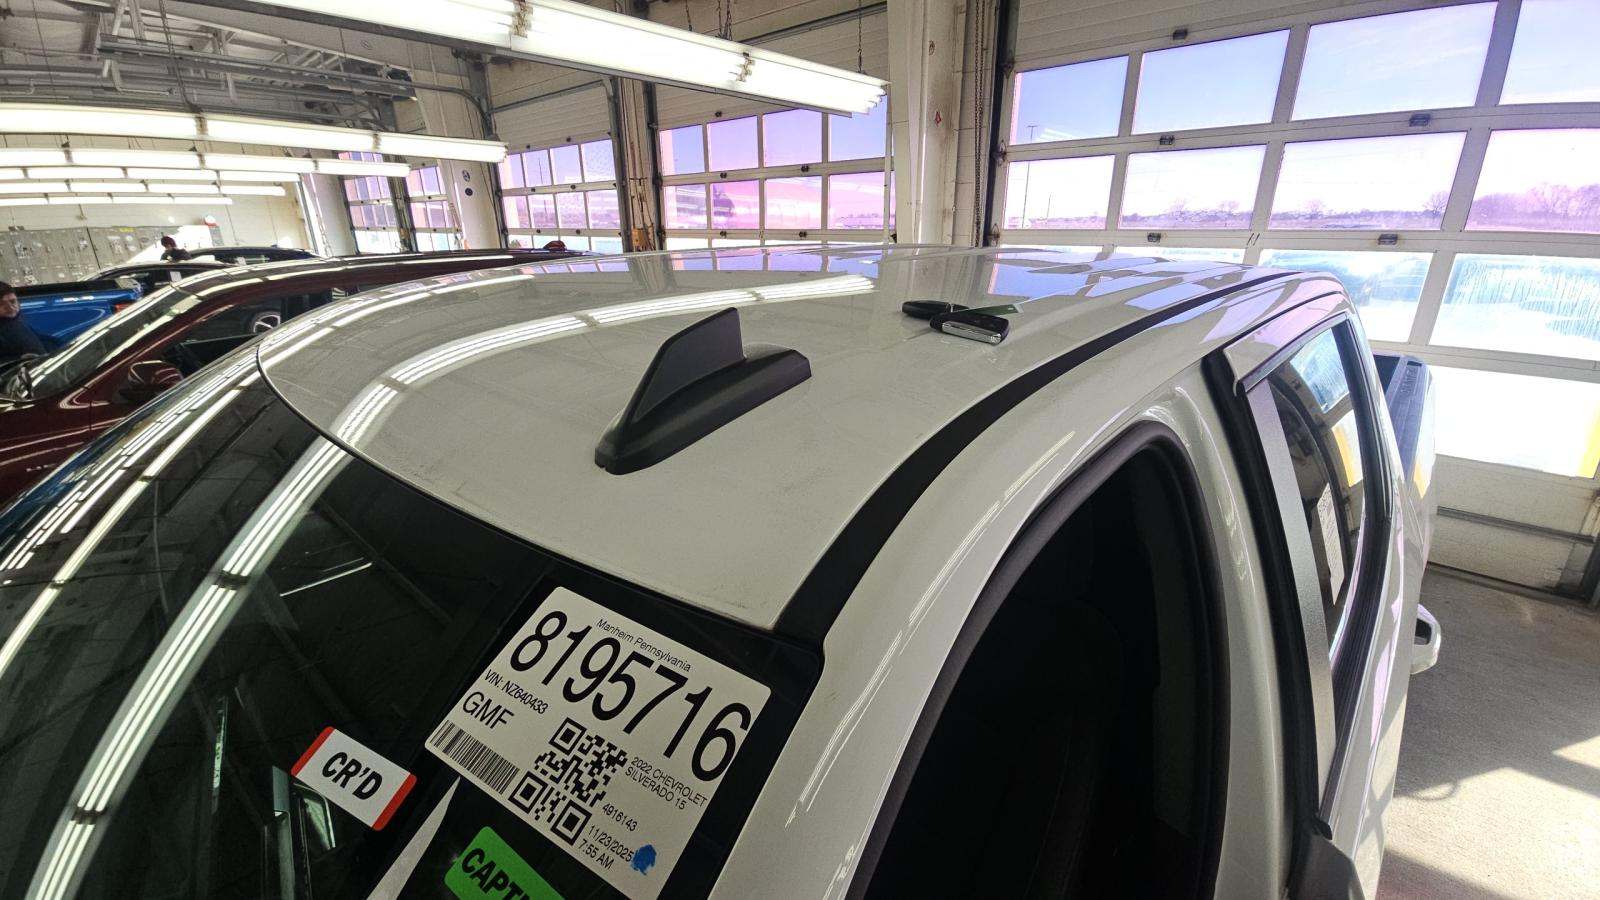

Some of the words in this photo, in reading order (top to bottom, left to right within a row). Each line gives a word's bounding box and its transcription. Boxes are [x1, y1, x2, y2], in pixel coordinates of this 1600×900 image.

[596, 619, 634, 643] Manheim
[634, 637, 692, 673] Pennsylvania
[462, 691, 515, 729] GMF
[484, 669, 504, 688] VIN:
[501, 680, 549, 715] NZ640433
[510, 610, 752, 782] 8195716
[322, 752, 383, 800] CR'D
[625, 766, 675, 802] SILVERADO
[675, 798, 687, 810] 15
[631, 757, 653, 774] 2022
[652, 769, 708, 807] CHEVROLET
[602, 803, 638, 832] 4916143
[578, 838, 600, 859] 7:55
[596, 852, 615, 870] AM
[588, 825, 635, 862] 11/23/2025
[461, 848, 530, 900] CAPT
